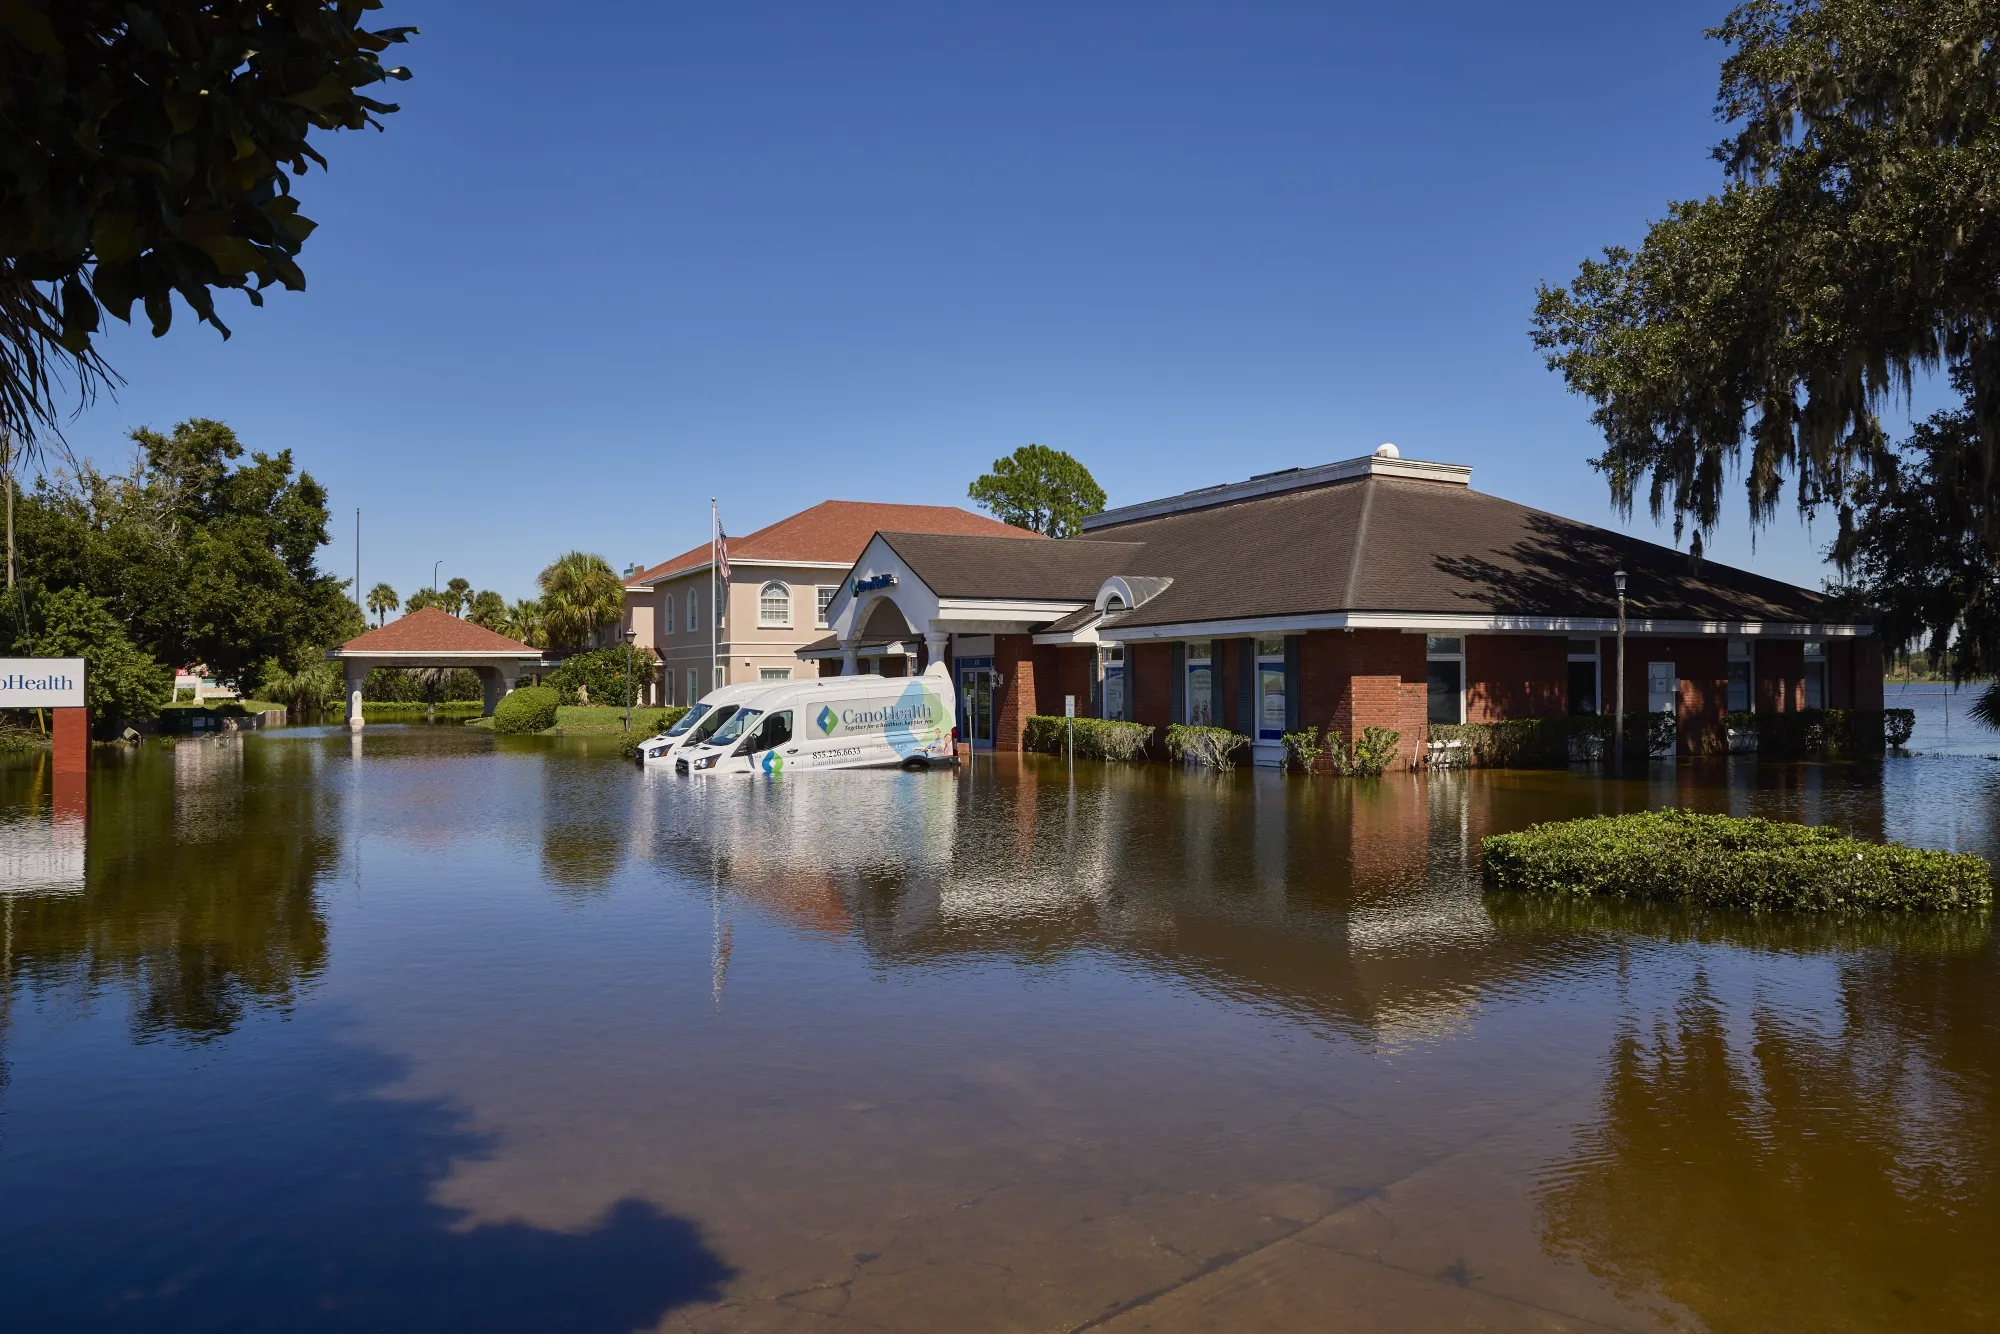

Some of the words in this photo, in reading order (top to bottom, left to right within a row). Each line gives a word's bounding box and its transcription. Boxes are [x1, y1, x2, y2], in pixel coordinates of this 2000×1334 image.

[843, 703, 932, 725] CanoHealth
[867, 722, 875, 730] for
[812, 747, 861, 759] 855.226.6633
[812, 756, 863, 766] CanoHealth.com
